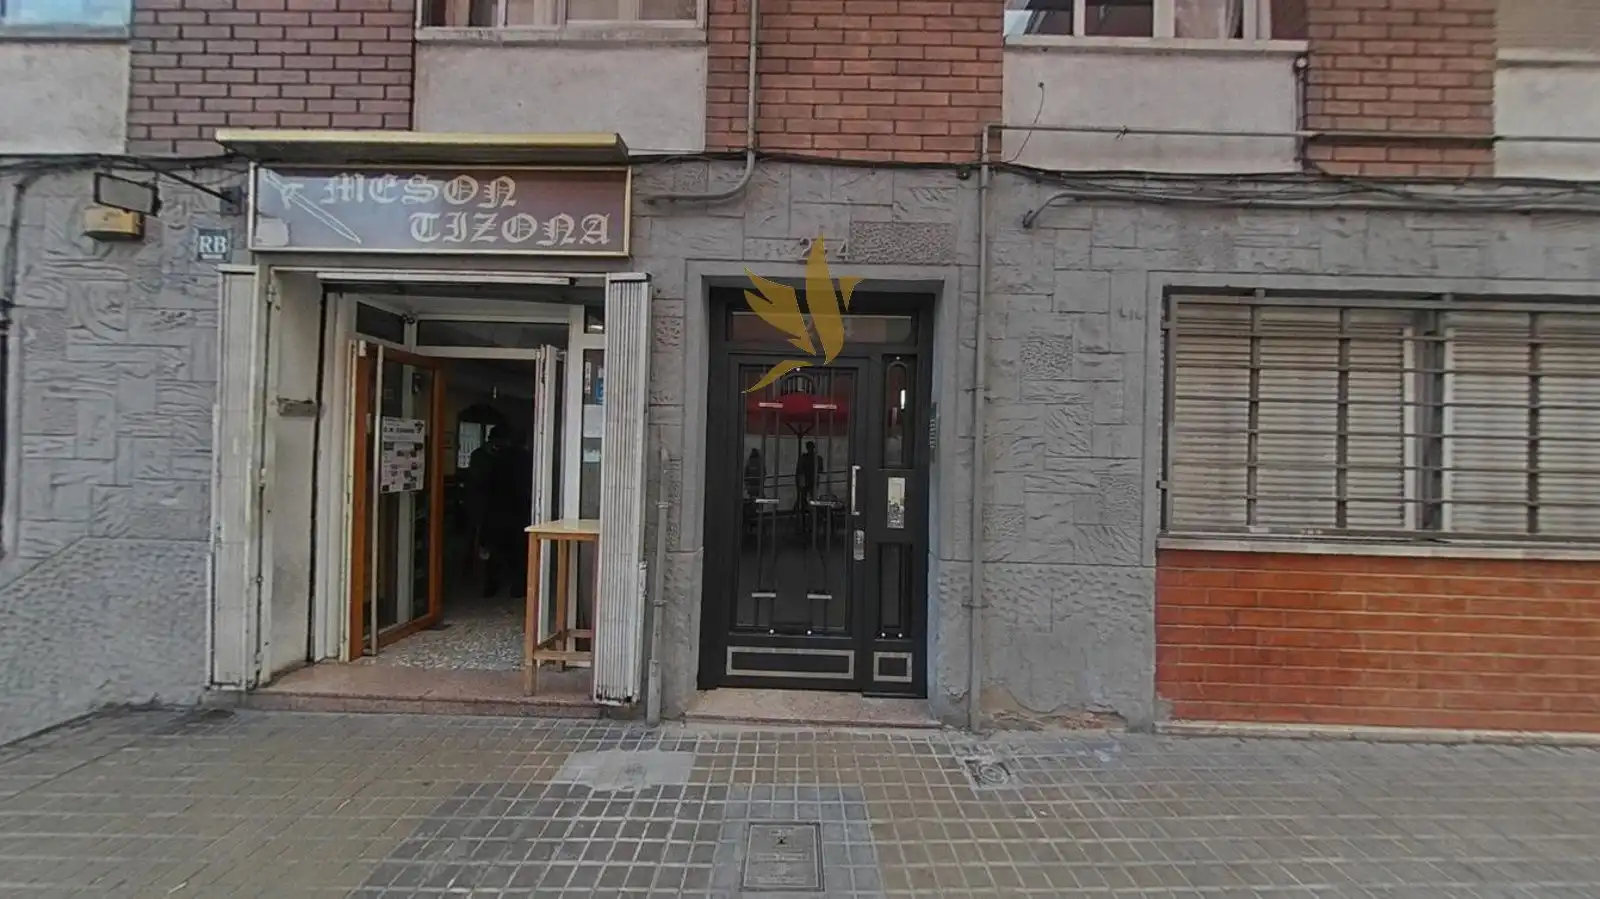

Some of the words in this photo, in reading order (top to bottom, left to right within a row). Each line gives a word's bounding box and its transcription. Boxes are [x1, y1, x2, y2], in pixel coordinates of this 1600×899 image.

[320, 172, 517, 208] MESON
[200, 235, 227, 253] RB
[409, 211, 611, 245] TIZONA
